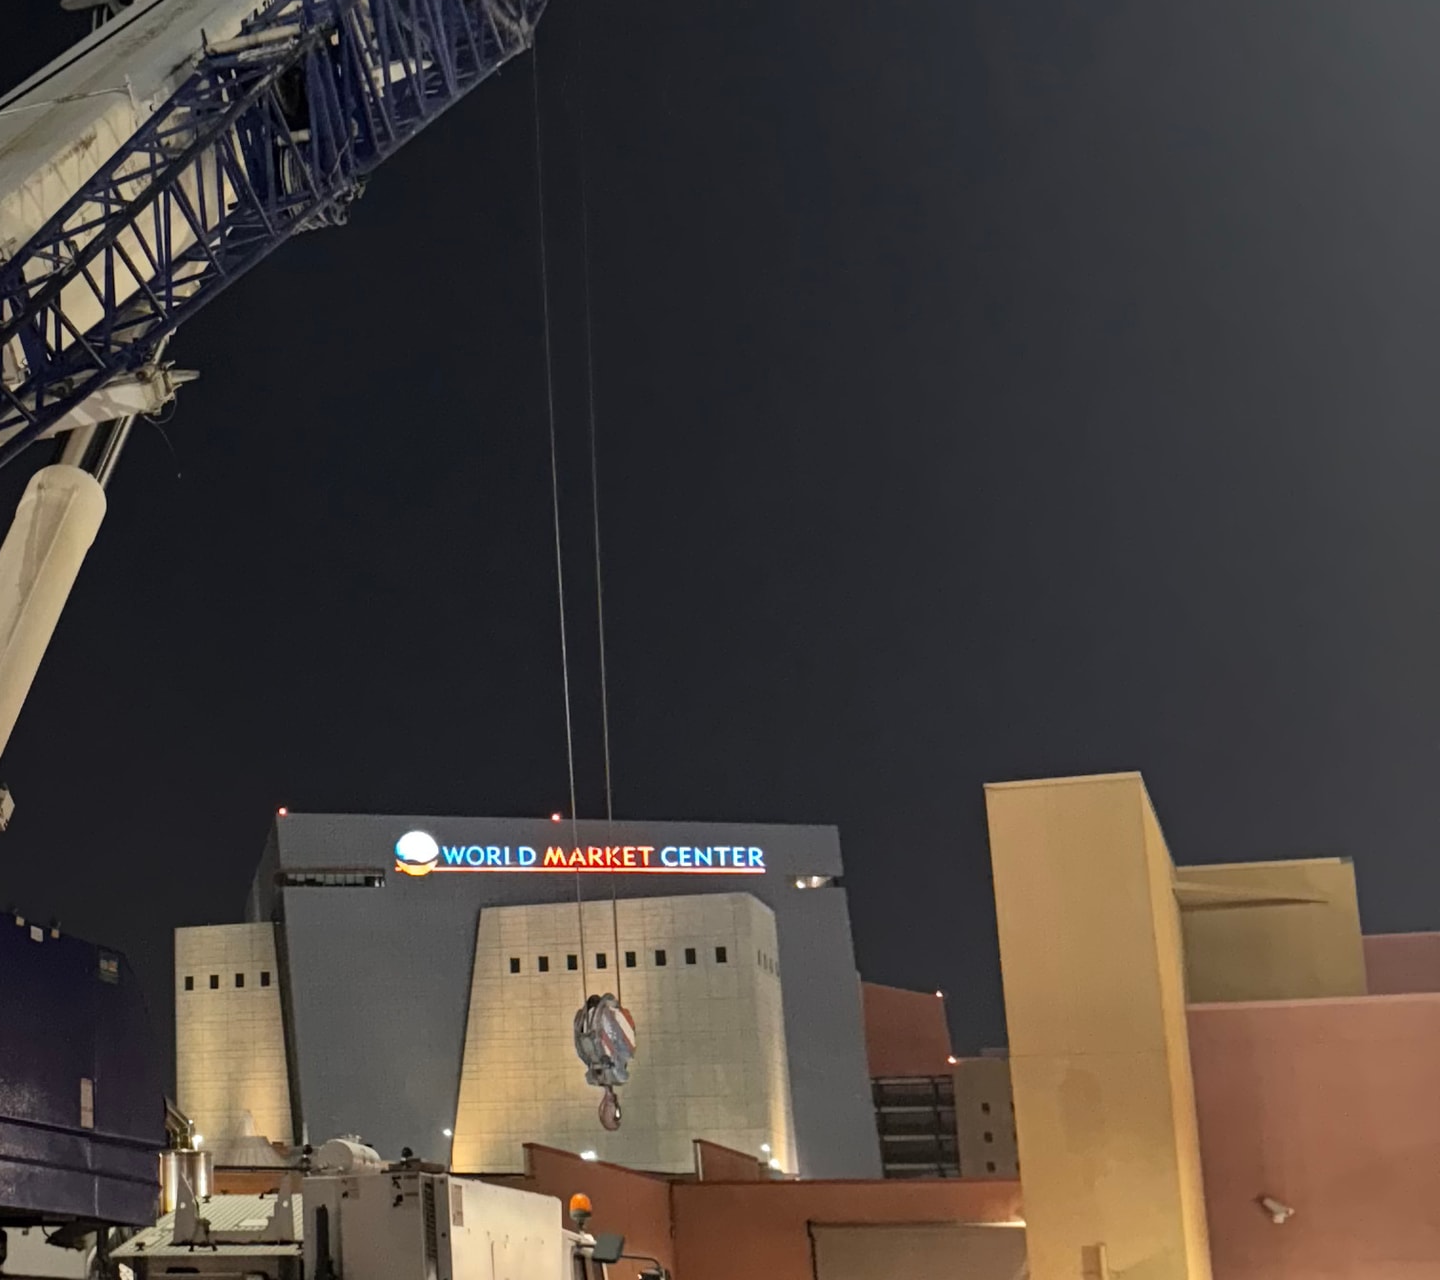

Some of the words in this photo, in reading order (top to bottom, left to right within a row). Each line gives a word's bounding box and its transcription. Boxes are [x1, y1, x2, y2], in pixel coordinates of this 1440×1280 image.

[442, 845, 536, 867] WORLD
[543, 845, 654, 867] MARKET
[660, 845, 765, 867] CENTER
